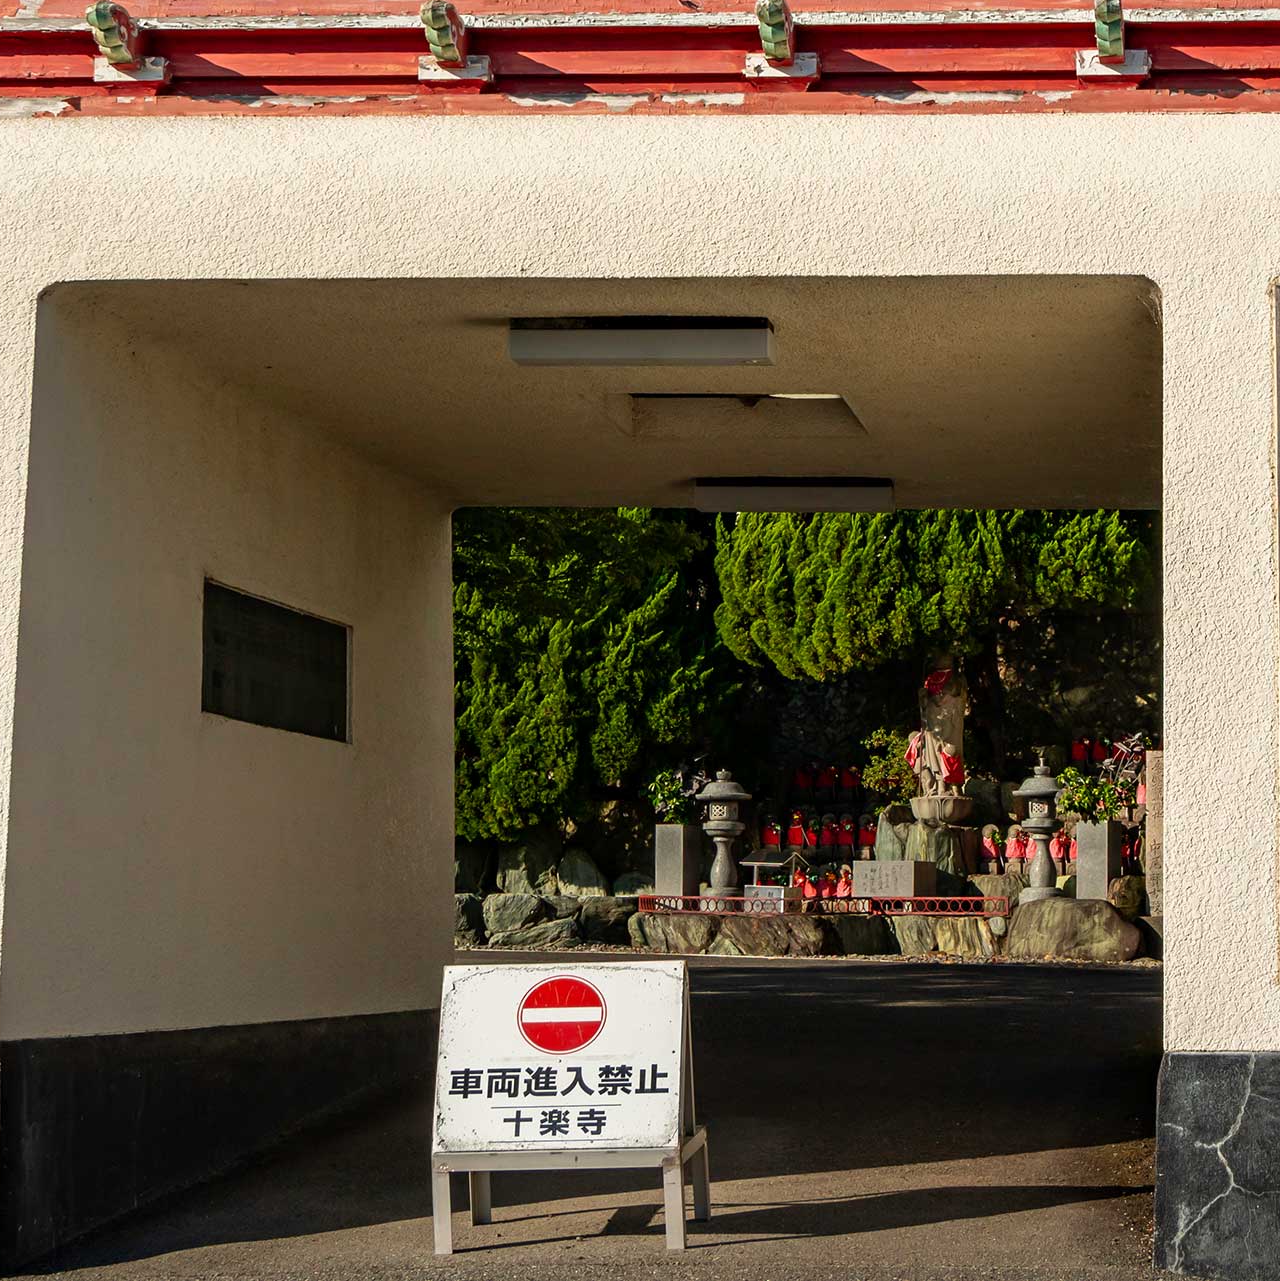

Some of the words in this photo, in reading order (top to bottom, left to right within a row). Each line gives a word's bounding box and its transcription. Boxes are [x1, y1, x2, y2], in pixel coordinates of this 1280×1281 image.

[448, 1064, 669, 1099] 車両進入禁止
[503, 1108, 607, 1137] 十楽寺
